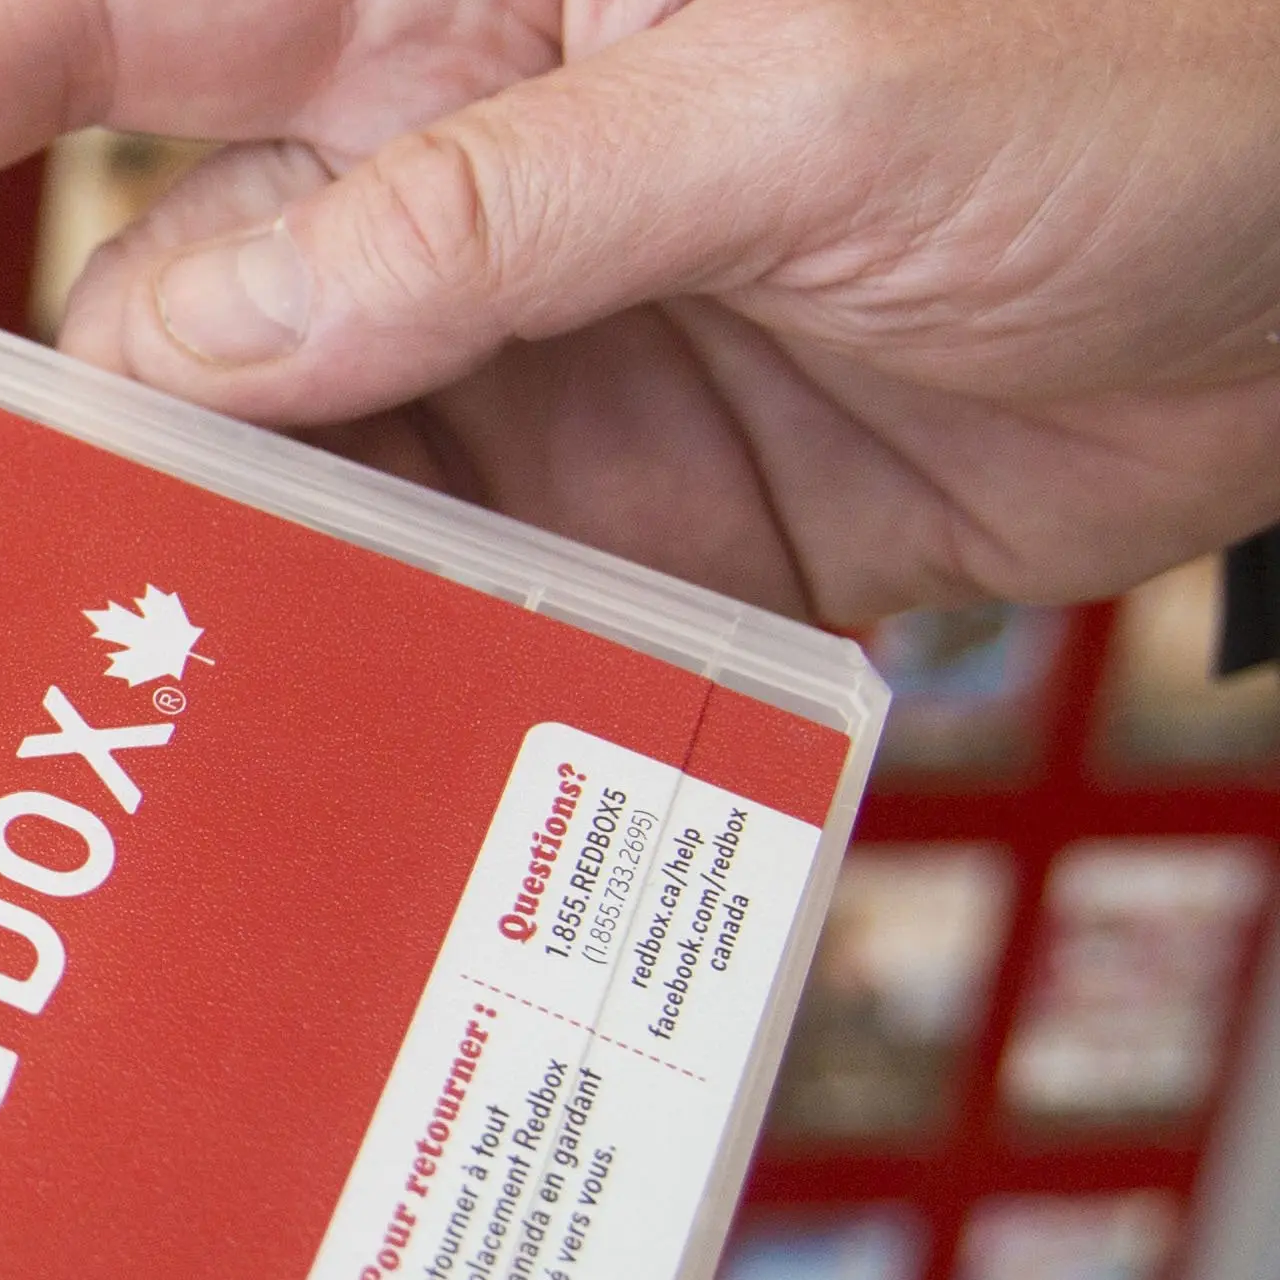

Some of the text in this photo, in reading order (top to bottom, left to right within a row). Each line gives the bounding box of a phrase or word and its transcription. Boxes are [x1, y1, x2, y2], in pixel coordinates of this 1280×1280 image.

[497, 762, 587, 944] Questions?
[545, 787, 627, 958] 1.855.REDBOX5
[581, 809, 659, 965] (1.855.733.2695)
[631, 827, 705, 988] redbox.ca/help
[648, 807, 748, 1040] facebook.com/redbox
[710, 894, 749, 972] canada
[461, 1164, 488, 1181] à
[472, 1105, 510, 1158] tout
[512, 1059, 568, 1151] Redbox
[540, 1172, 565, 1203] en
[554, 1067, 602, 1168] gardant
[557, 1213, 591, 1264] vers
[578, 1144, 617, 1206] vous.
